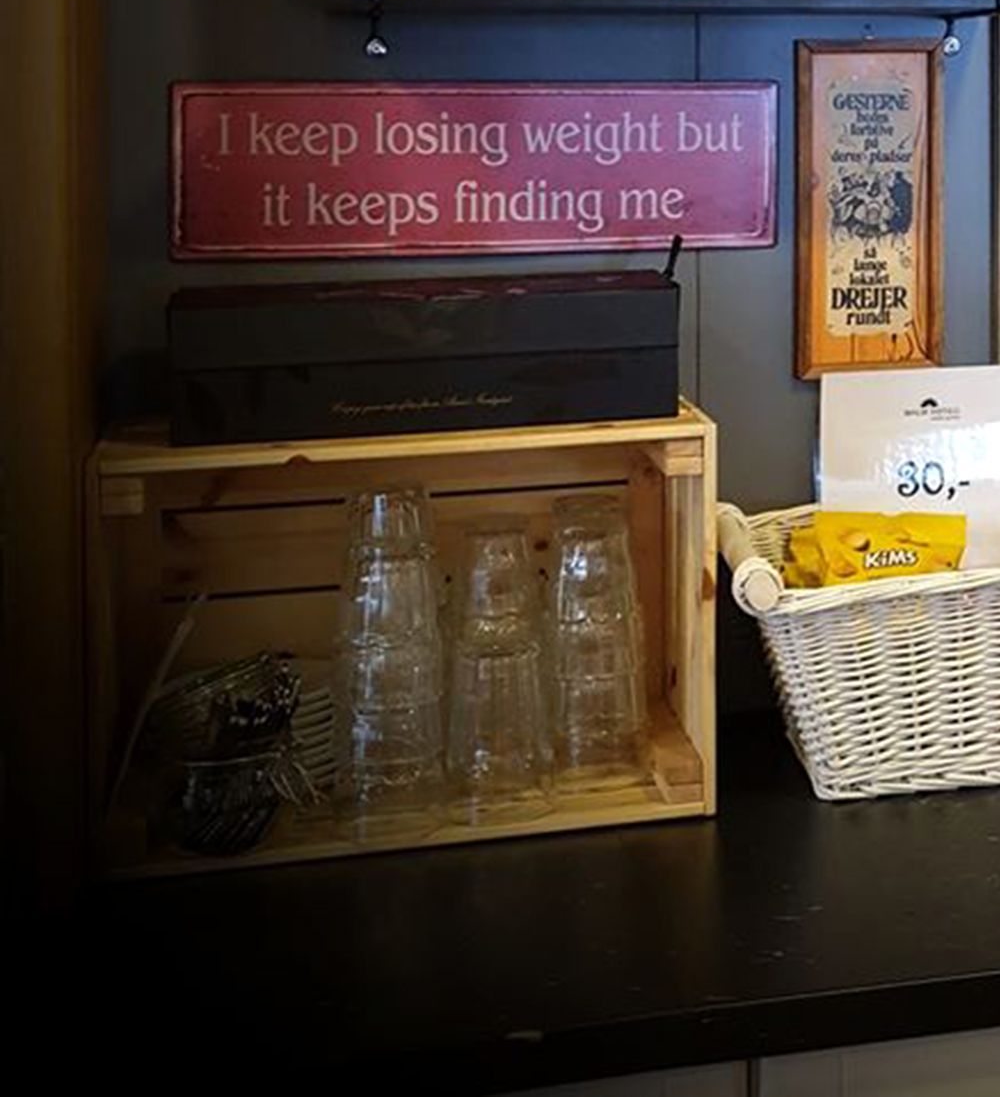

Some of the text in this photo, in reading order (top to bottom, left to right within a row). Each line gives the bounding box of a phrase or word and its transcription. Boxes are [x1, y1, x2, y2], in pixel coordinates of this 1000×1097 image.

[219, 111, 744, 166] I keep losing weight but
[262, 181, 683, 235] it keeps finding me
[831, 285, 908, 310] DREJER
[846, 310, 891, 326] rundt
[897, 460, 970, 500] 30,-
